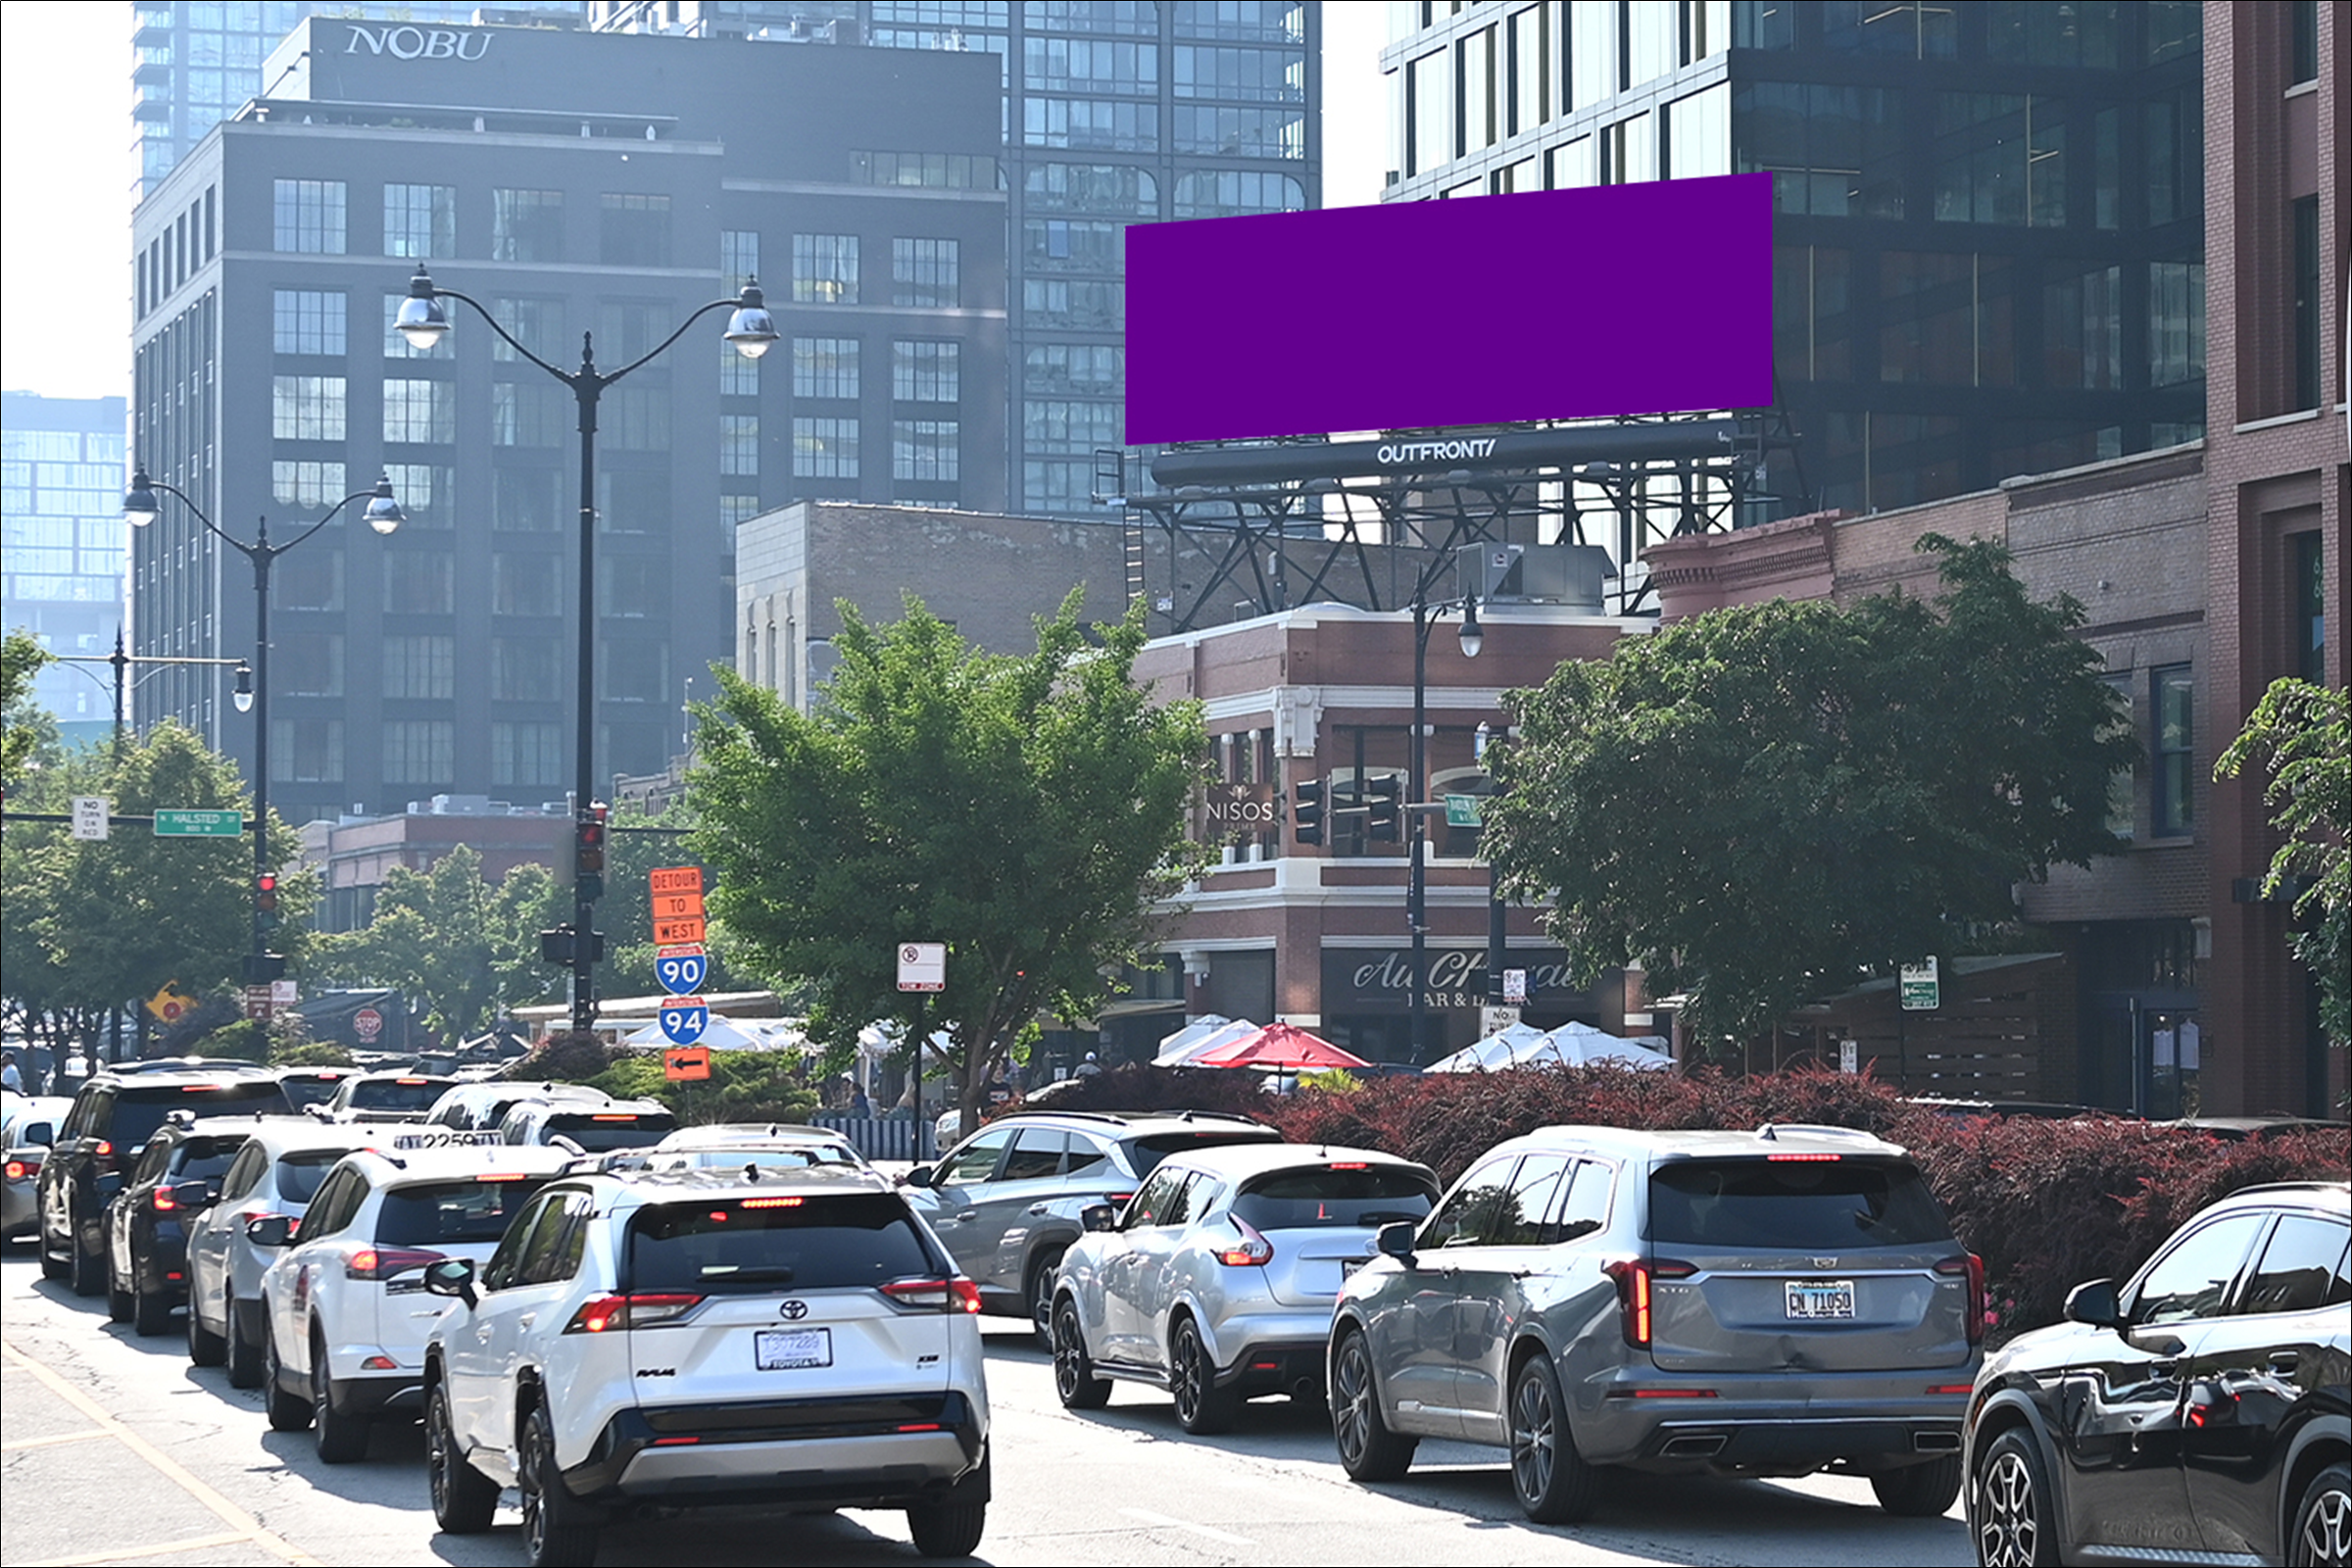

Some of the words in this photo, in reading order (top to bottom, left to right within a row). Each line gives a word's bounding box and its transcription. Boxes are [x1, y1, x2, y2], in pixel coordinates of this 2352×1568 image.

[344, 25, 495, 61] NOBU
[83, 801, 99, 809] NO
[1207, 802, 1273, 821] NISOS
[172, 813, 220, 824] HALSTED
[653, 872, 698, 889] DETOUR
[669, 899, 686, 912] TO
[660, 923, 695, 939] WEST
[662, 959, 700, 984] 90
[1353, 952, 1413, 988] Au
[1453, 992, 1467, 1007] &
[356, 1016, 381, 1030] STOP
[665, 1010, 703, 1034] 94
[1493, 1011, 1509, 1020] NO
[423, 1133, 474, 1150] 2259
[1811, 1292, 1851, 1309] 71050
